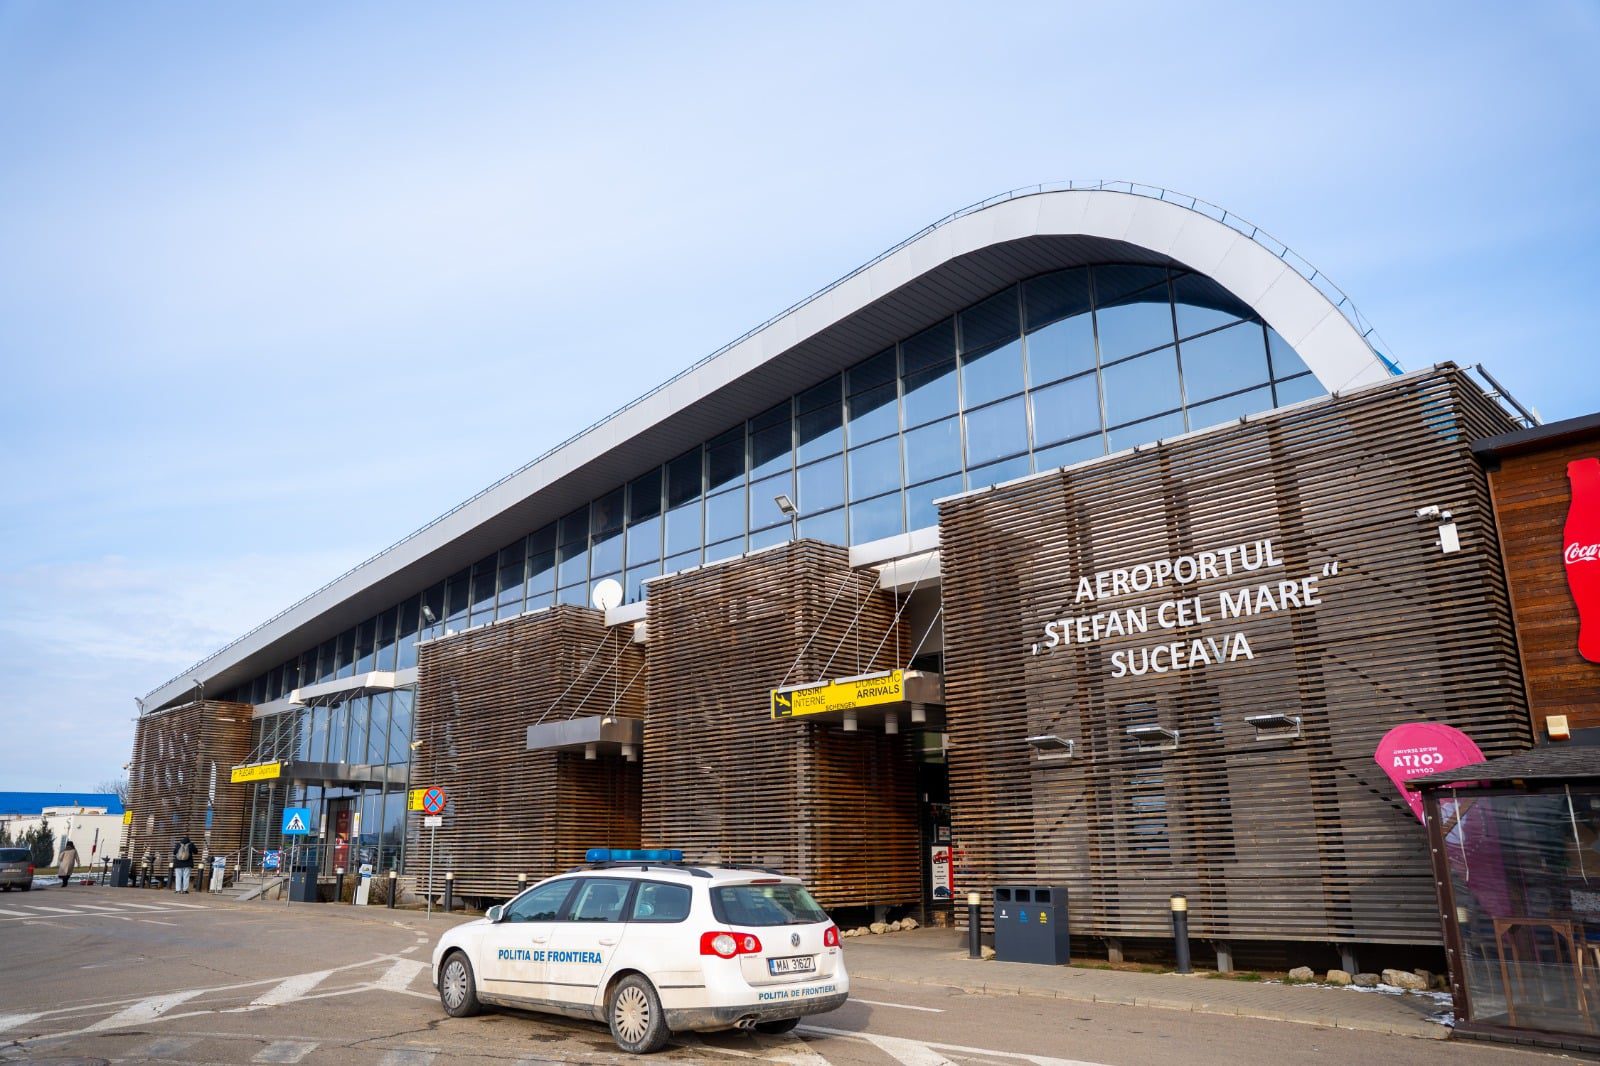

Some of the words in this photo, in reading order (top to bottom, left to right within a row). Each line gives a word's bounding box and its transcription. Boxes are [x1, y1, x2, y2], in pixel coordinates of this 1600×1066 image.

[1565, 542, 1600, 564] Coca
[1075, 539, 1283, 603] AEROPORTUL
[1157, 597, 1211, 629] CEL
[1111, 632, 1254, 678] SUCEAVA
[857, 684, 900, 699] ARRIVALS
[794, 695, 826, 708] INTERNE
[825, 702, 856, 711] SCHENGEN
[498, 949, 530, 961] POLITIA
[533, 951, 545, 962] DE
[547, 951, 602, 964] FRONTIERA
[776, 960, 790, 971] MAI
[792, 958, 812, 969] 31627
[758, 991, 788, 1000] POLITIA
[791, 989, 800, 997] DE
[802, 985, 836, 996] FRONTIERA
